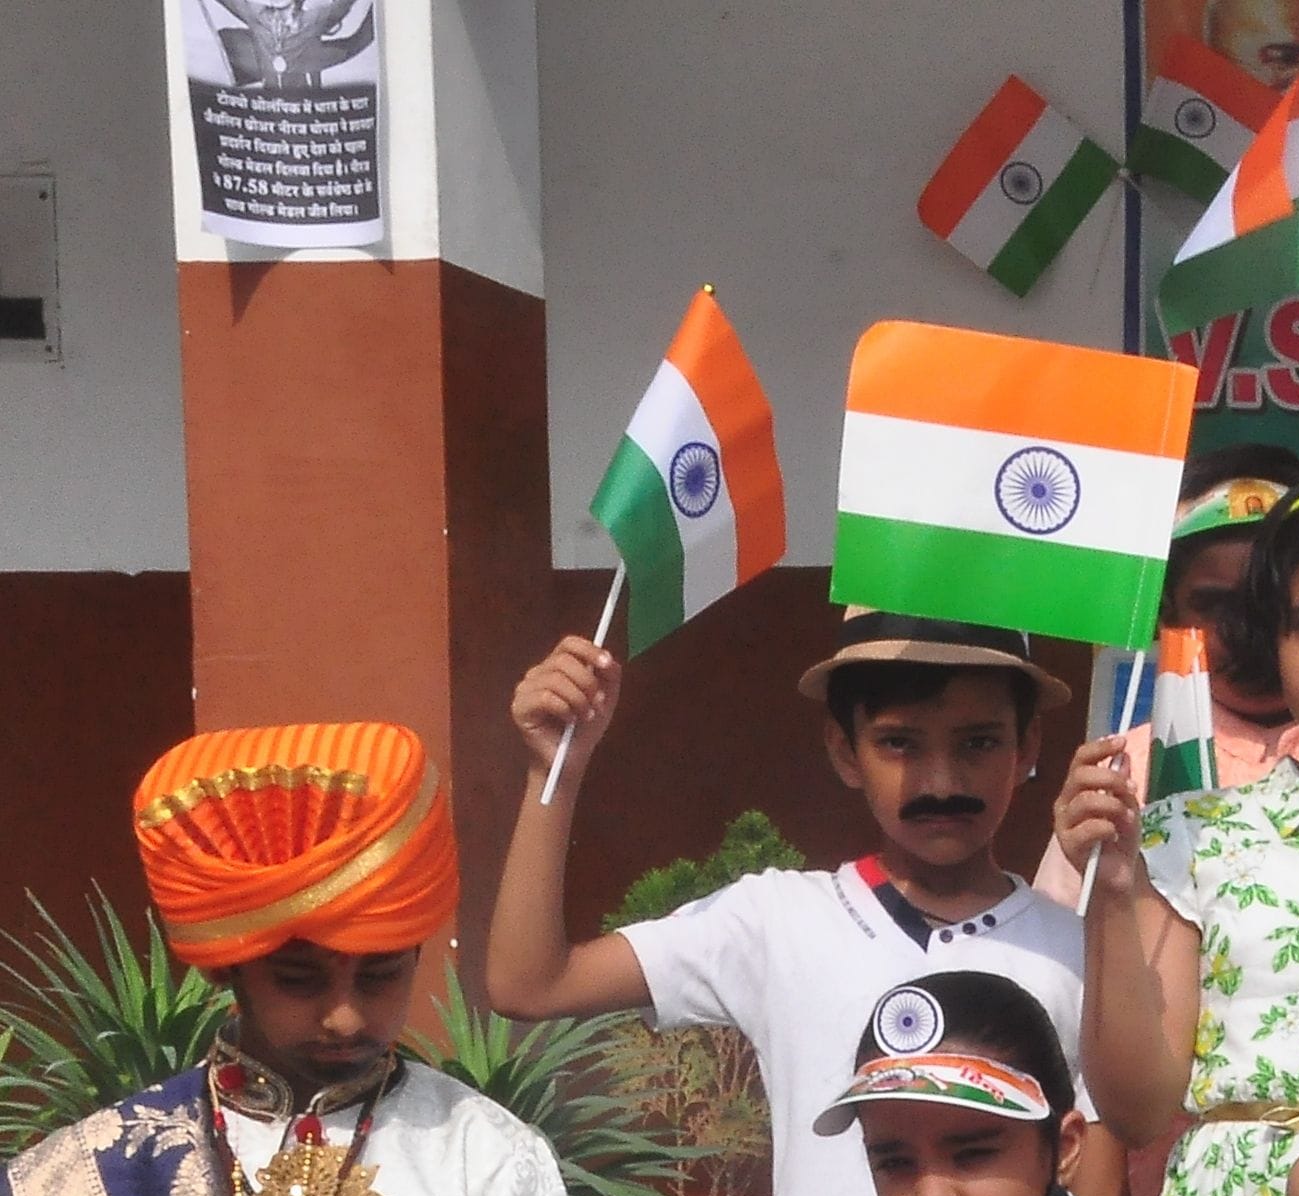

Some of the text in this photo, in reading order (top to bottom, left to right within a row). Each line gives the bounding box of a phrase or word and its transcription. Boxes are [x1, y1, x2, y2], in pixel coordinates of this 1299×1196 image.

[314, 101, 338, 113] भारत
[339, 96, 350, 110] के
[278, 119, 307, 134] नीरज
[340, 117, 347, 130] ने
[329, 139, 342, 153] को
[223, 174, 268, 195] 87.58
[271, 181, 299, 197] मीटर
[302, 181, 314, 196] के
